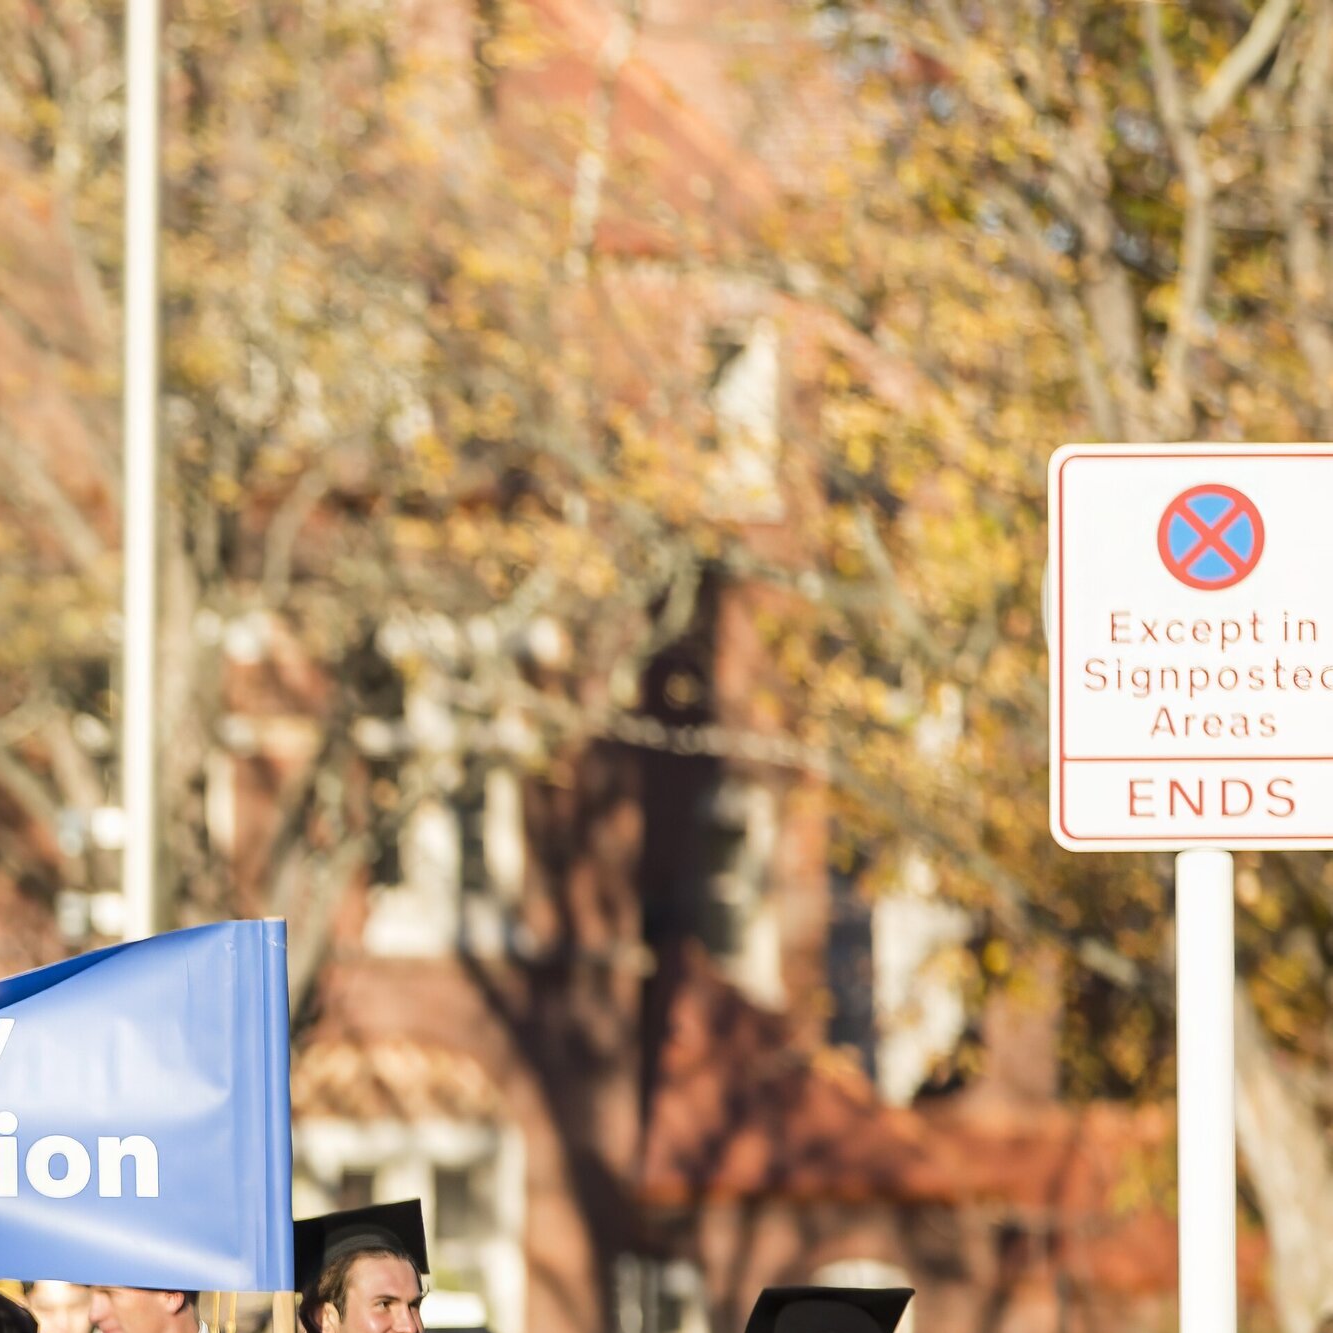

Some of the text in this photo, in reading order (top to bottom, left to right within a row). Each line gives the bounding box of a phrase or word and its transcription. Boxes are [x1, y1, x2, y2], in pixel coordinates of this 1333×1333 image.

[1110, 610, 1318, 652] Except in
[1150, 705, 1277, 738] Areas
[1128, 776, 1297, 819] ENDS
